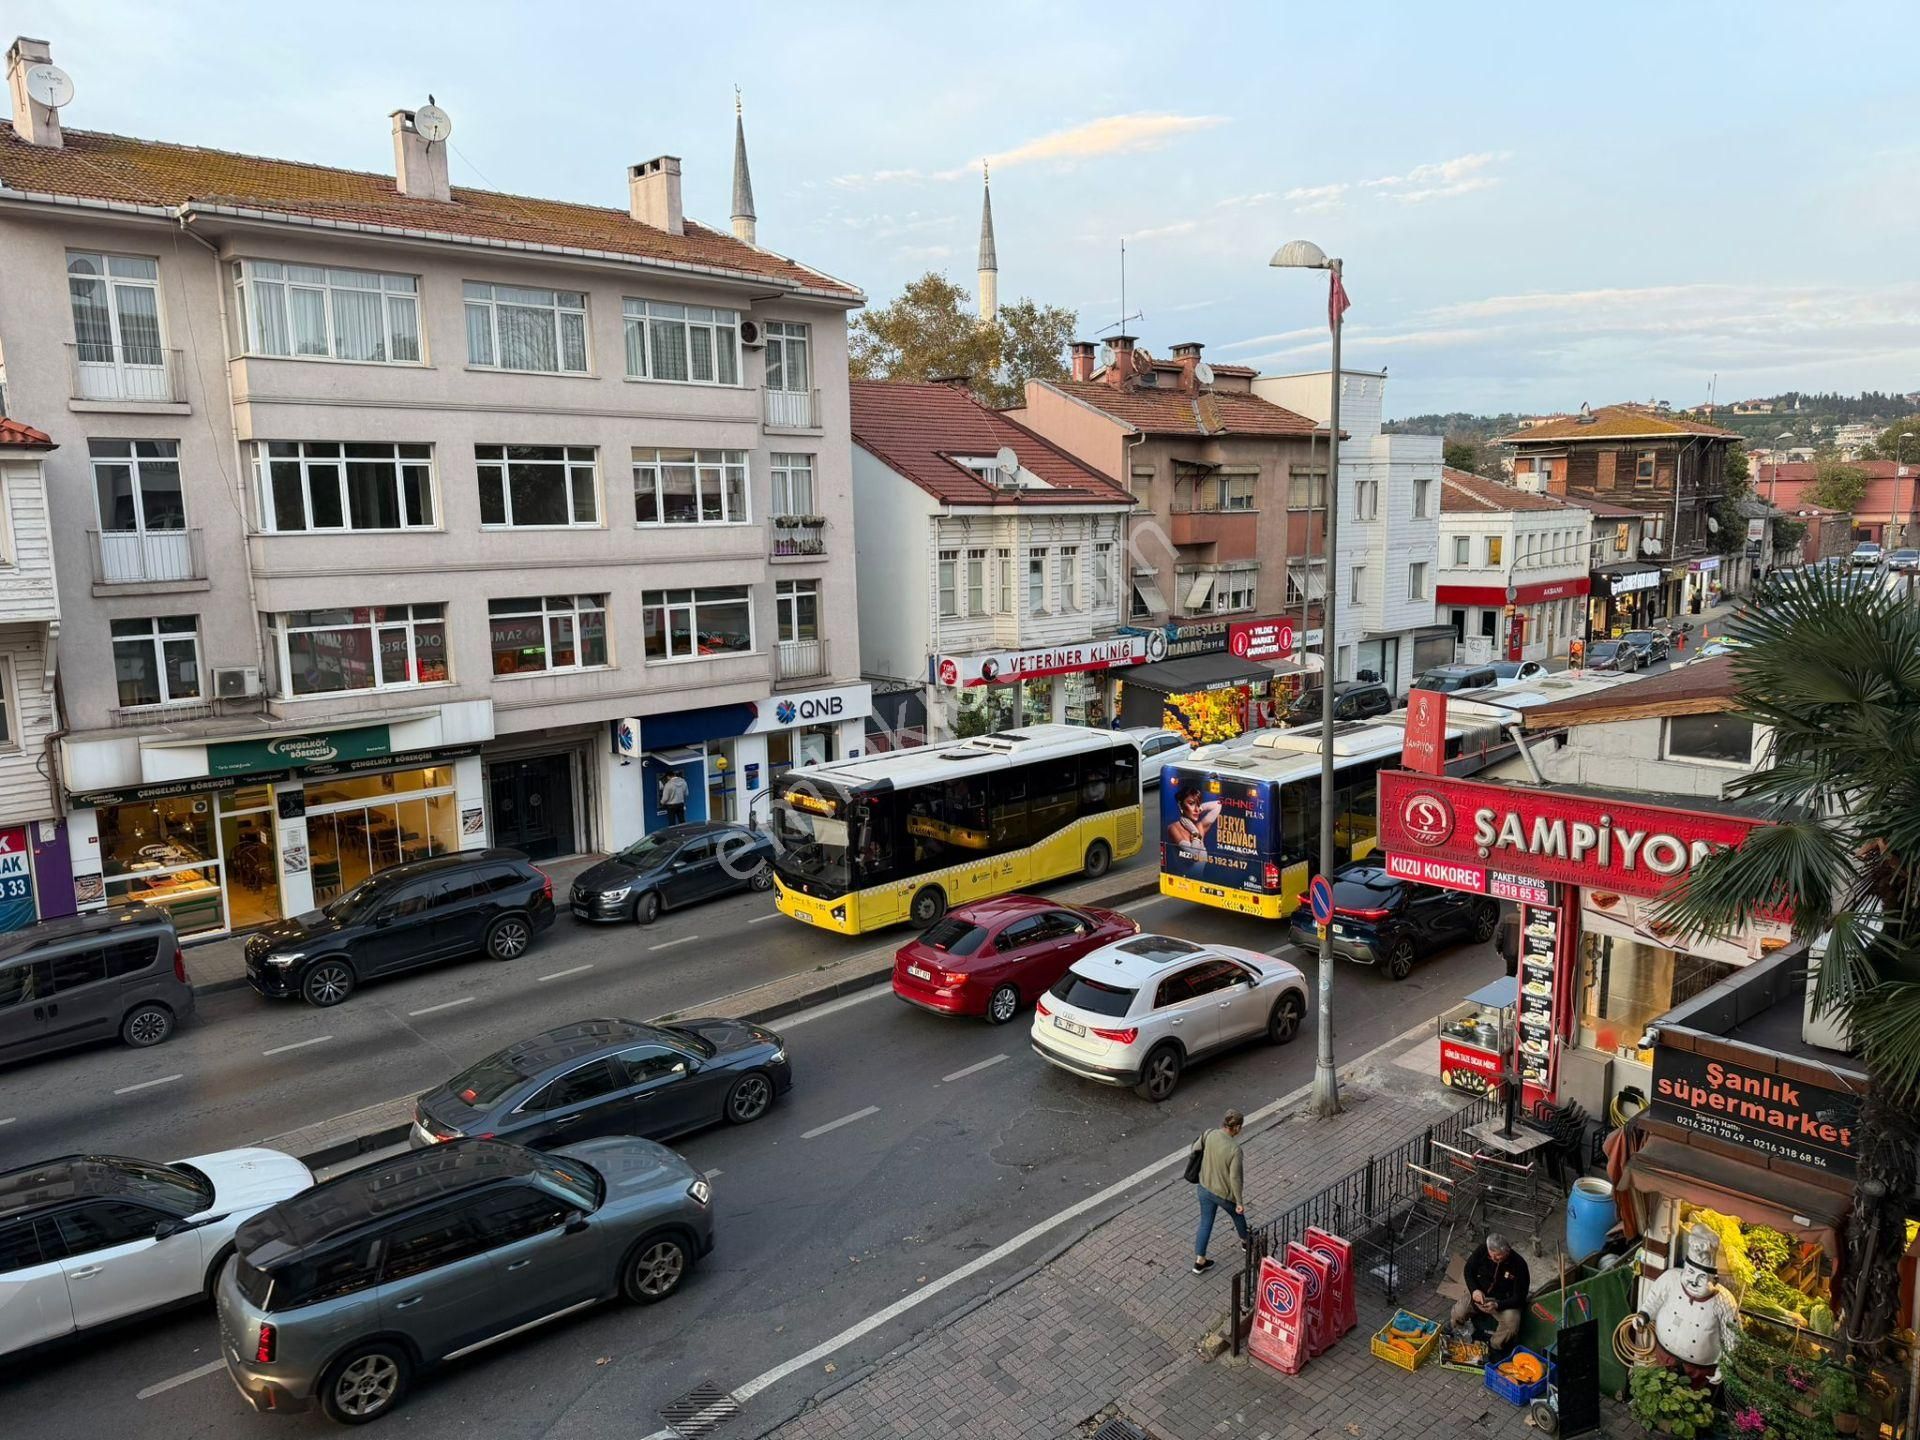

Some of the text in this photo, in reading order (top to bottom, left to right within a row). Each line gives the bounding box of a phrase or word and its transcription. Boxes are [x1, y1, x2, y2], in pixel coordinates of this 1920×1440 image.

[1543, 586, 1564, 596] AKBANK
[1178, 622, 1226, 639] ARDEŞLER
[1254, 625, 1274, 635] YILDIZ
[1168, 640, 1202, 656] MANAV
[1251, 635, 1276, 645] MARKET
[1010, 649, 1082, 672] VETERİNER
[1090, 640, 1134, 661] KLİNİĞİ
[1247, 643, 1279, 658] ŞARKÜTERİ
[800, 696, 843, 719] QNB
[280, 738, 328, 752] ÇENGELKÖY
[290, 746, 331, 759] BÖREKÇİSİ
[350, 757, 392, 770] ÇENGELKÖY
[395, 752, 433, 763] BÖREKÇİSİ
[137, 779, 235, 798] ÇENGELKÖY BÖREKÇİSİ
[1217, 814, 1246, 833] DERYA
[1245, 810, 1265, 820] PLUS
[1216, 829, 1257, 849] BEDAVACI
[0, 856, 22, 874] AK
[1228, 858, 1238, 869] 34
[1239, 859, 1248, 870] 17
[1391, 856, 1481, 890] KUZU KOKOREÇ
[1493, 871, 1516, 883] PAKET
[9, 879, 26, 896] 33
[1243, 880, 1262, 891] Hilton
[1500, 884, 1547, 902] 318 65 55
[1706, 1062, 1800, 1107] Şanlık
[1658, 1077, 1852, 1148] süpermarket
[1695, 1113, 1721, 1127] Sipariş
[1676, 1115, 1699, 1129] 0216
[1701, 1122, 1717, 1135] 321
[1719, 1127, 1731, 1139] 70
[1732, 1131, 1745, 1143] 49
[1753, 1138, 1777, 1153] 0216
[1778, 1145, 1797, 1159] 318
[1799, 1151, 1812, 1163] 68
[1814, 1155, 1827, 1168] 54
[1258, 1308, 1296, 1333] PARK YAPILMAZ
